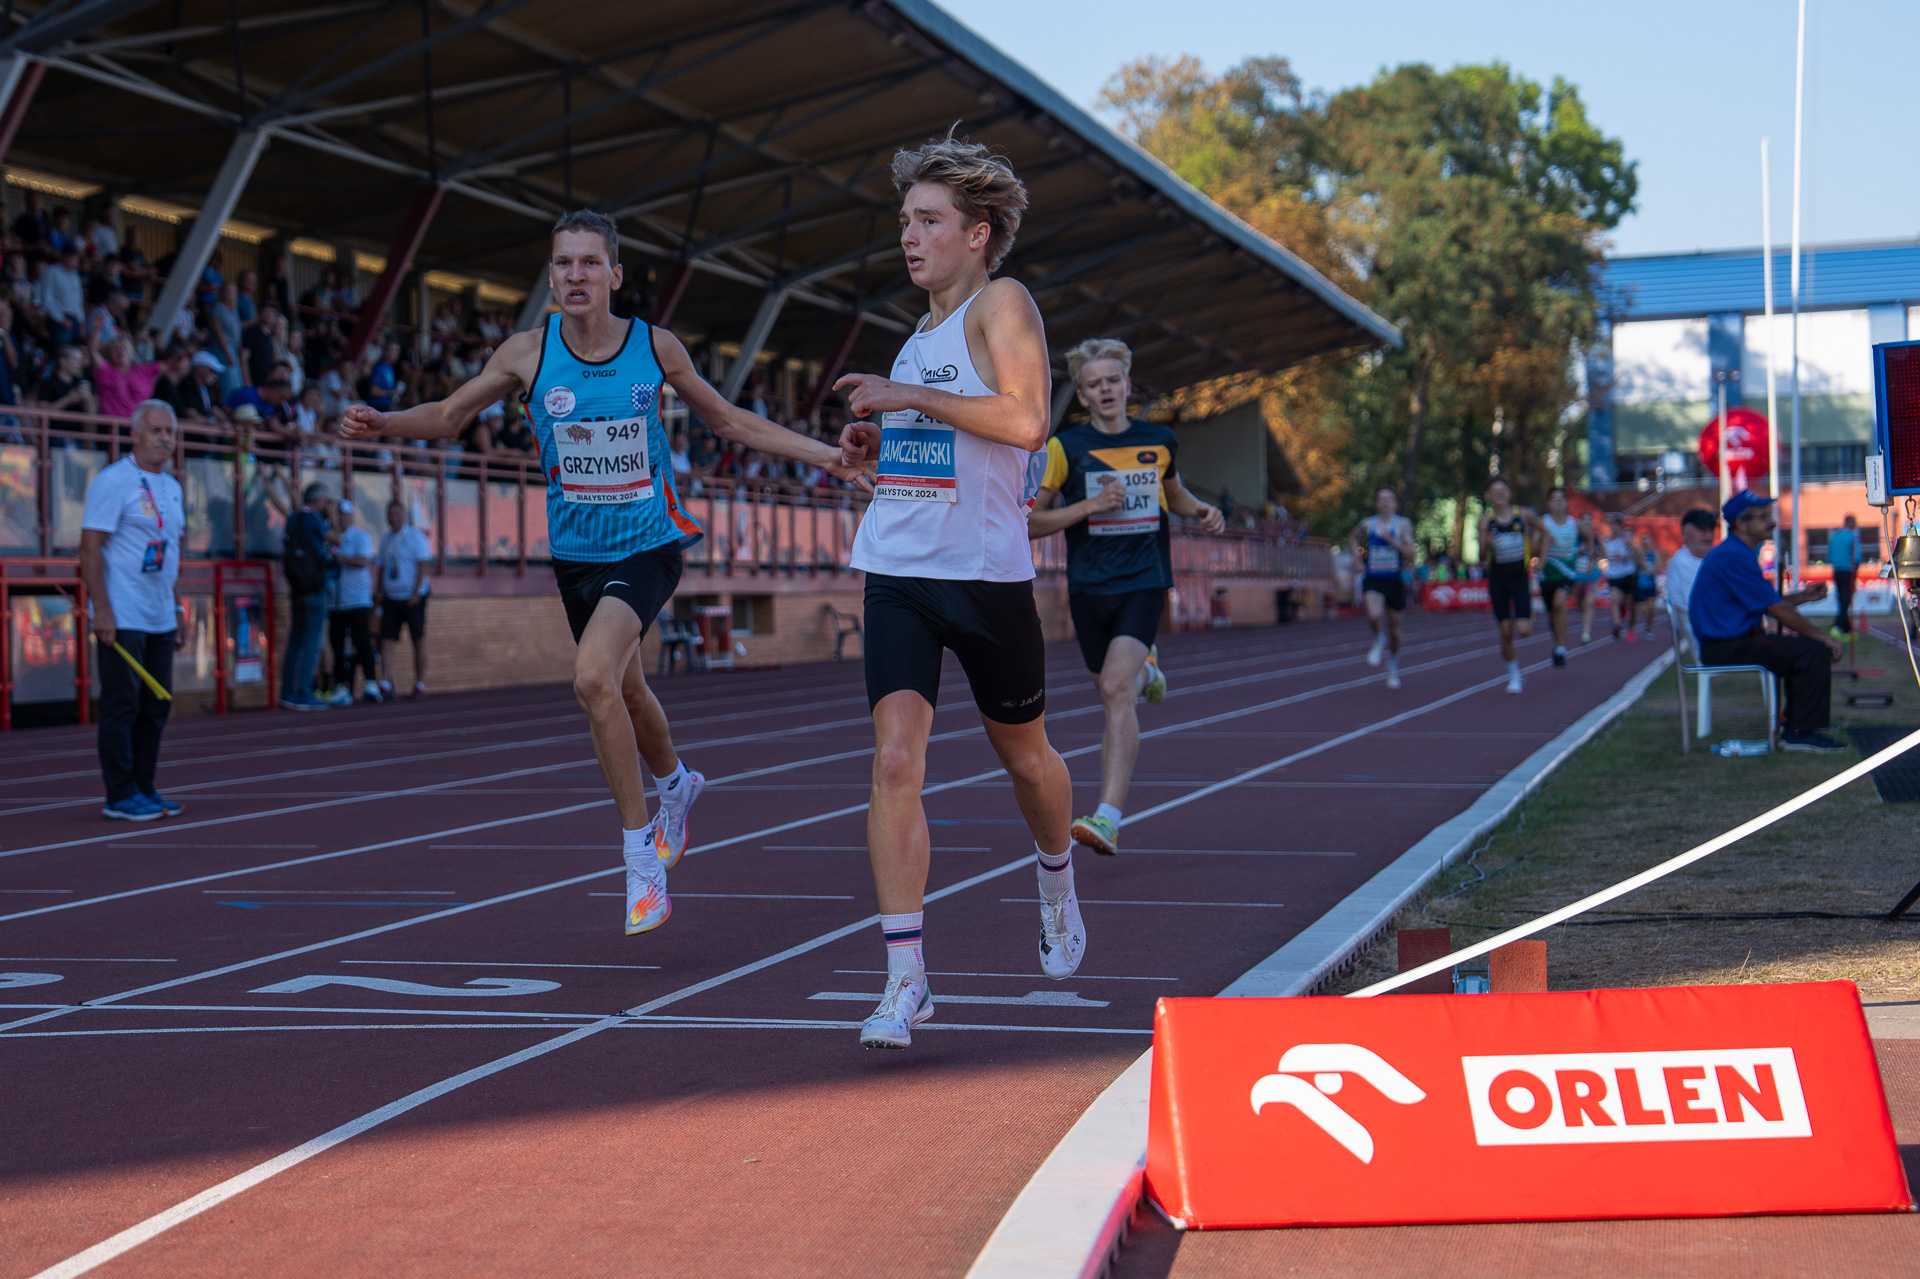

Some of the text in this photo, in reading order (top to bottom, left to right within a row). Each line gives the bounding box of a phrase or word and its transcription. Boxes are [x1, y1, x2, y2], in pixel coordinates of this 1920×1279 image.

[592, 369, 616, 378] VIGO
[915, 411, 943, 424] 24
[606, 422, 640, 442] 949
[563, 451, 644, 474] GRZYMSKI
[1126, 471, 1157, 486] 1052
[620, 492, 638, 500] 2024
[877, 488, 937, 498] BIAŁYSTOK 2024
[1020, 688, 1042, 706] JAKO
[247, 974, 562, 996] 2
[1488, 1063, 1784, 1130] ORLEN
